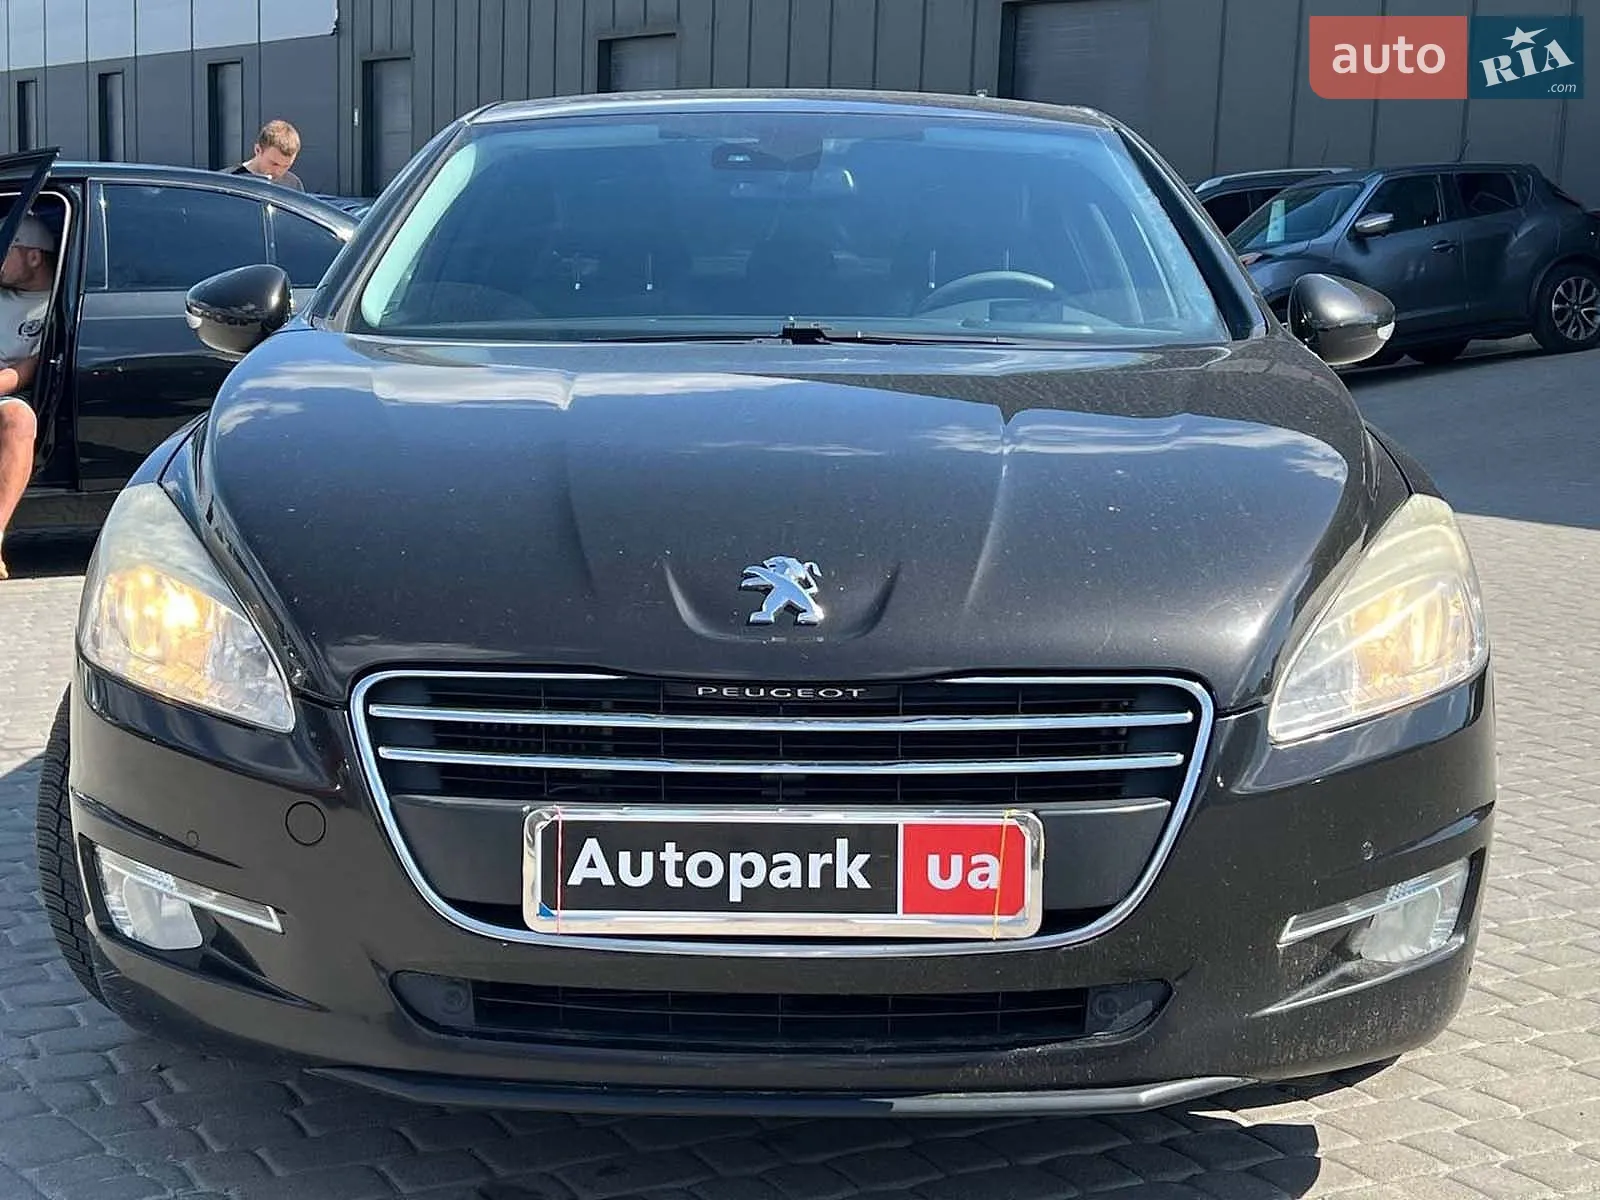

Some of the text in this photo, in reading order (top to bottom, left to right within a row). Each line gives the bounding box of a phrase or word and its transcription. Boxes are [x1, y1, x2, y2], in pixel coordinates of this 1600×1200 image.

[697, 687, 867, 698] PEUGEOT
[567, 838, 1000, 902] Autopark ua
